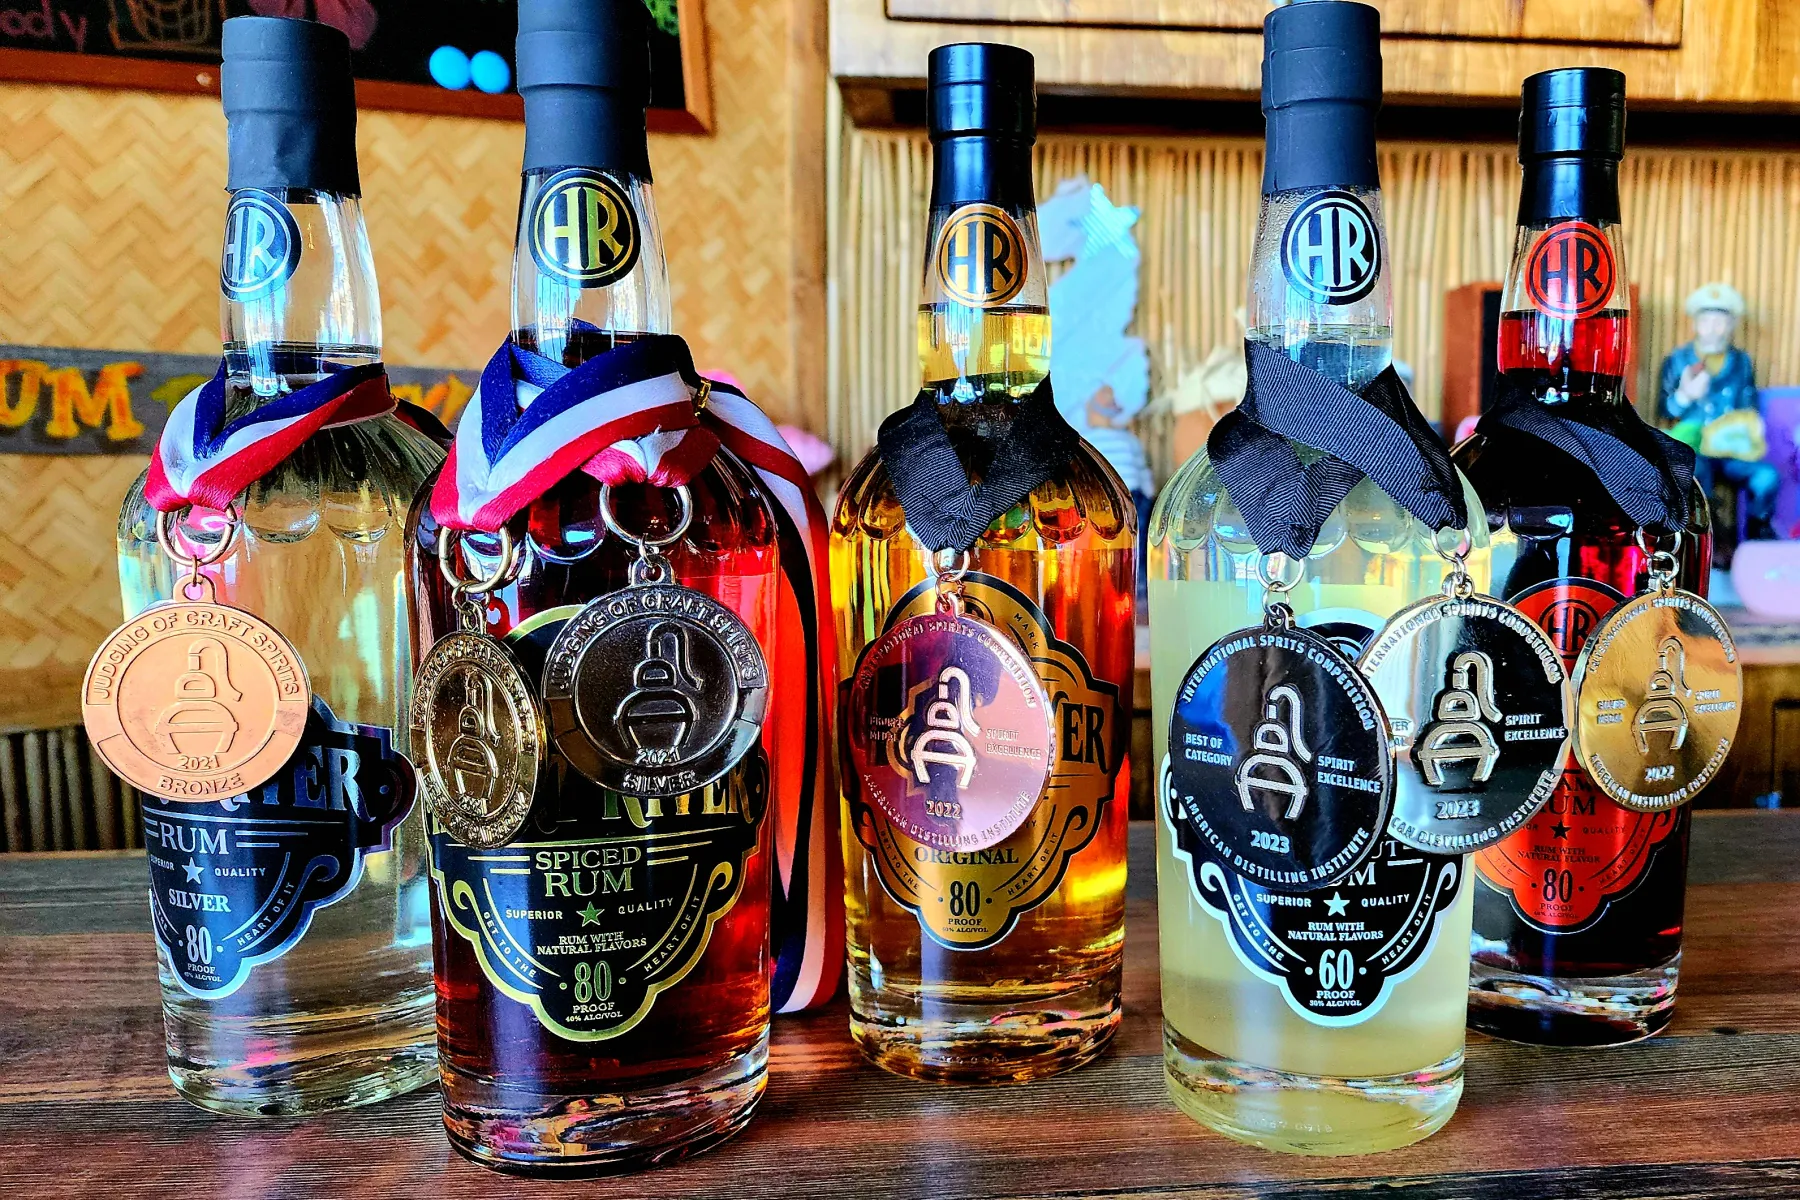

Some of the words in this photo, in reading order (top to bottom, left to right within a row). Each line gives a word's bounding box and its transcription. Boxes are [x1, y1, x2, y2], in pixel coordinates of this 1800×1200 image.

[542, 185, 625, 271] HR
[222, 206, 279, 284] HR
[947, 219, 1014, 294] HR
[1298, 206, 1371, 289] HR
[1540, 237, 1603, 305] HR
[1013, 612, 1040, 650] MARK
[1547, 606, 1590, 652] HR
[551, 611, 607, 691] JUDGING
[607, 596, 638, 617] OF
[641, 592, 715, 620] CRAFT
[709, 612, 760, 681] SPIRITS
[1363, 604, 1442, 679] TERNATIONAL
[1498, 611, 1562, 685] COMPETITION
[93, 626, 149, 700] JUDGING
[153, 612, 179, 632] OF
[186, 610, 254, 638] CRAFT
[252, 631, 300, 697] SPIRITS
[1181, 636, 1258, 705] INTERNATIONAL
[1259, 634, 1306, 655] SPRITS
[1306, 648, 1377, 732] COMPETITION
[1504, 713, 1543, 726] SPIRIT
[1051, 690, 1109, 776] ER
[1185, 733, 1209, 748] BEST
[1210, 736, 1224, 750] OF
[1504, 727, 1566, 742] EXCELLENCE
[177, 754, 221, 771] 2021
[634, 748, 681, 765] 2021
[986, 742, 1042, 761] EXCELLENCE
[1185, 748, 1234, 768] CATEGORY
[1316, 755, 1356, 772] SPIRIT
[156, 772, 246, 796] BRONZE
[622, 770, 701, 793] SILVER
[1316, 771, 1382, 795] EXCELLENCE
[1644, 766, 1676, 782] 2022
[925, 799, 963, 819] 2022
[981, 790, 1033, 844] INSTITUTE
[1434, 800, 1481, 820] 2023
[160, 820, 230, 855] RUM
[1184, 794, 1232, 859] AMERICAN
[1233, 853, 1309, 885] DISTILLING
[1311, 825, 1371, 883] INSTITUTE
[1249, 829, 1291, 855] 2023
[1417, 826, 1499, 850] DISTILLING
[1582, 826, 1626, 835] QUALITY
[535, 846, 642, 871] SPICED
[913, 846, 1020, 866] ORIGINAL
[1517, 850, 1562, 862] NATURAL
[1533, 845, 1558, 854] RUM
[1559, 846, 1586, 855] WITH
[213, 866, 267, 878] QUALITY
[892, 856, 902, 870] TO
[902, 870, 920, 891] THE
[1006, 865, 1040, 895] HEART
[1040, 848, 1052, 863] OF
[1050, 832, 1058, 844] IT
[544, 866, 634, 898] RUM
[1542, 867, 1574, 903] 80
[168, 887, 232, 913] SILVER
[505, 908, 564, 921] SUPERIOR
[618, 897, 675, 915] QUALITY
[949, 880, 981, 917] 80
[1256, 893, 1313, 909] SUPERIOR
[1360, 893, 1411, 908] QUALITY
[1540, 902, 1574, 911] PROOF
[236, 915, 273, 947] HEART
[272, 898, 287, 914] OF
[286, 880, 295, 896] IT
[948, 917, 983, 927] PROOF
[643, 933, 680, 973] HEART
[680, 915, 693, 931] OF
[692, 895, 701, 911] IT
[1233, 894, 1249, 919] GET
[1248, 921, 1261, 937] TO
[1262, 938, 1286, 963] THE
[1287, 930, 1338, 942] NATURAL
[1338, 929, 1385, 942] FLAVORS
[1308, 921, 1335, 932] RUM
[1335, 921, 1366, 932] WITH
[1381, 930, 1414, 965] HEART
[1414, 909, 1425, 927] OF
[1423, 893, 1432, 907] IT
[185, 924, 213, 965] 80
[483, 911, 499, 936] GET
[499, 938, 512, 955] TO
[514, 955, 537, 979] THE
[536, 943, 593, 956] NATURAL
[595, 937, 648, 954] FLAVORS
[559, 933, 589, 947] RUM
[589, 931, 624, 945] WITH
[187, 962, 217, 975] PROOF
[1318, 948, 1355, 991] 60
[574, 960, 613, 1004] 80
[1309, 999, 1325, 1007] 30%
[1325, 999, 1363, 1008] ALC/VOL
[1316, 989, 1356, 1000] PROOF
[572, 1001, 616, 1014] PROOF
[583, 1011, 623, 1022] ALC/VOL
